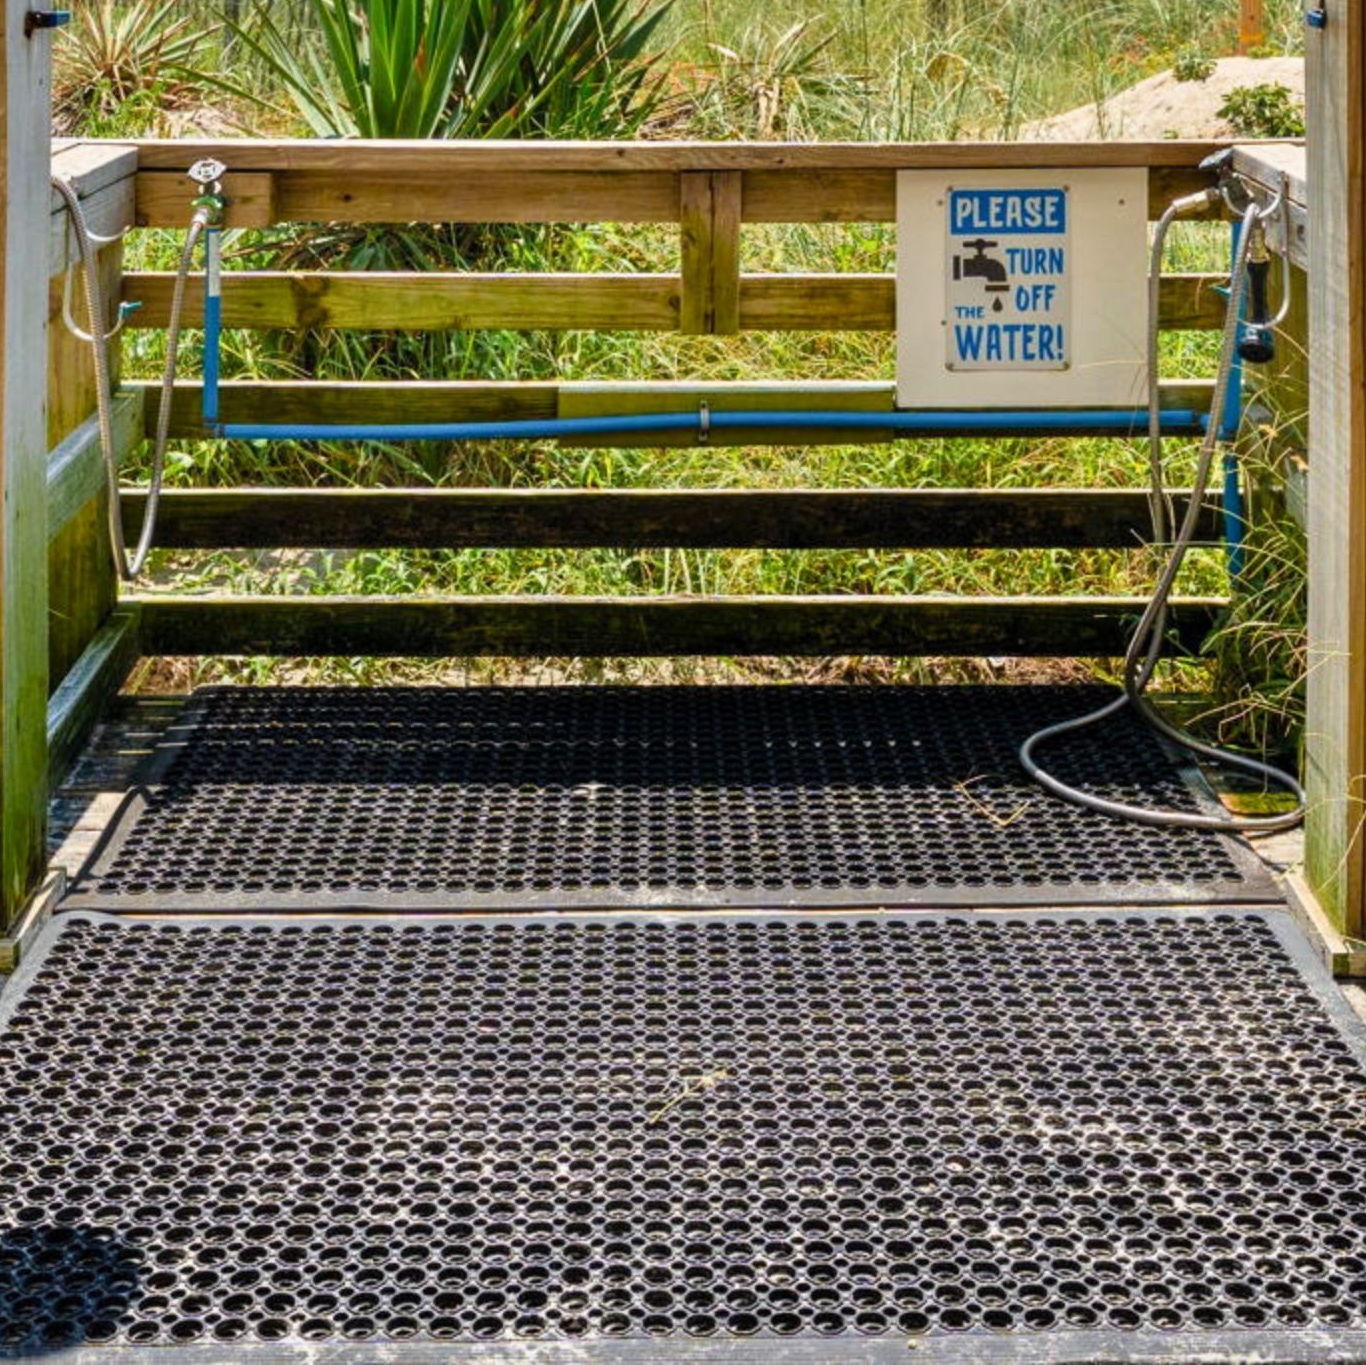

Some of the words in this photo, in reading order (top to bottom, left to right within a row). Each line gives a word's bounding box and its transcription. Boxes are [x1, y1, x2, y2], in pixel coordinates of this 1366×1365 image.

[956, 196, 1059, 228] PLEASE
[1006, 248, 1064, 274] TURN
[1015, 285, 1056, 311] OFF
[954, 306, 985, 319] THE
[954, 324, 1064, 362] WATER!
